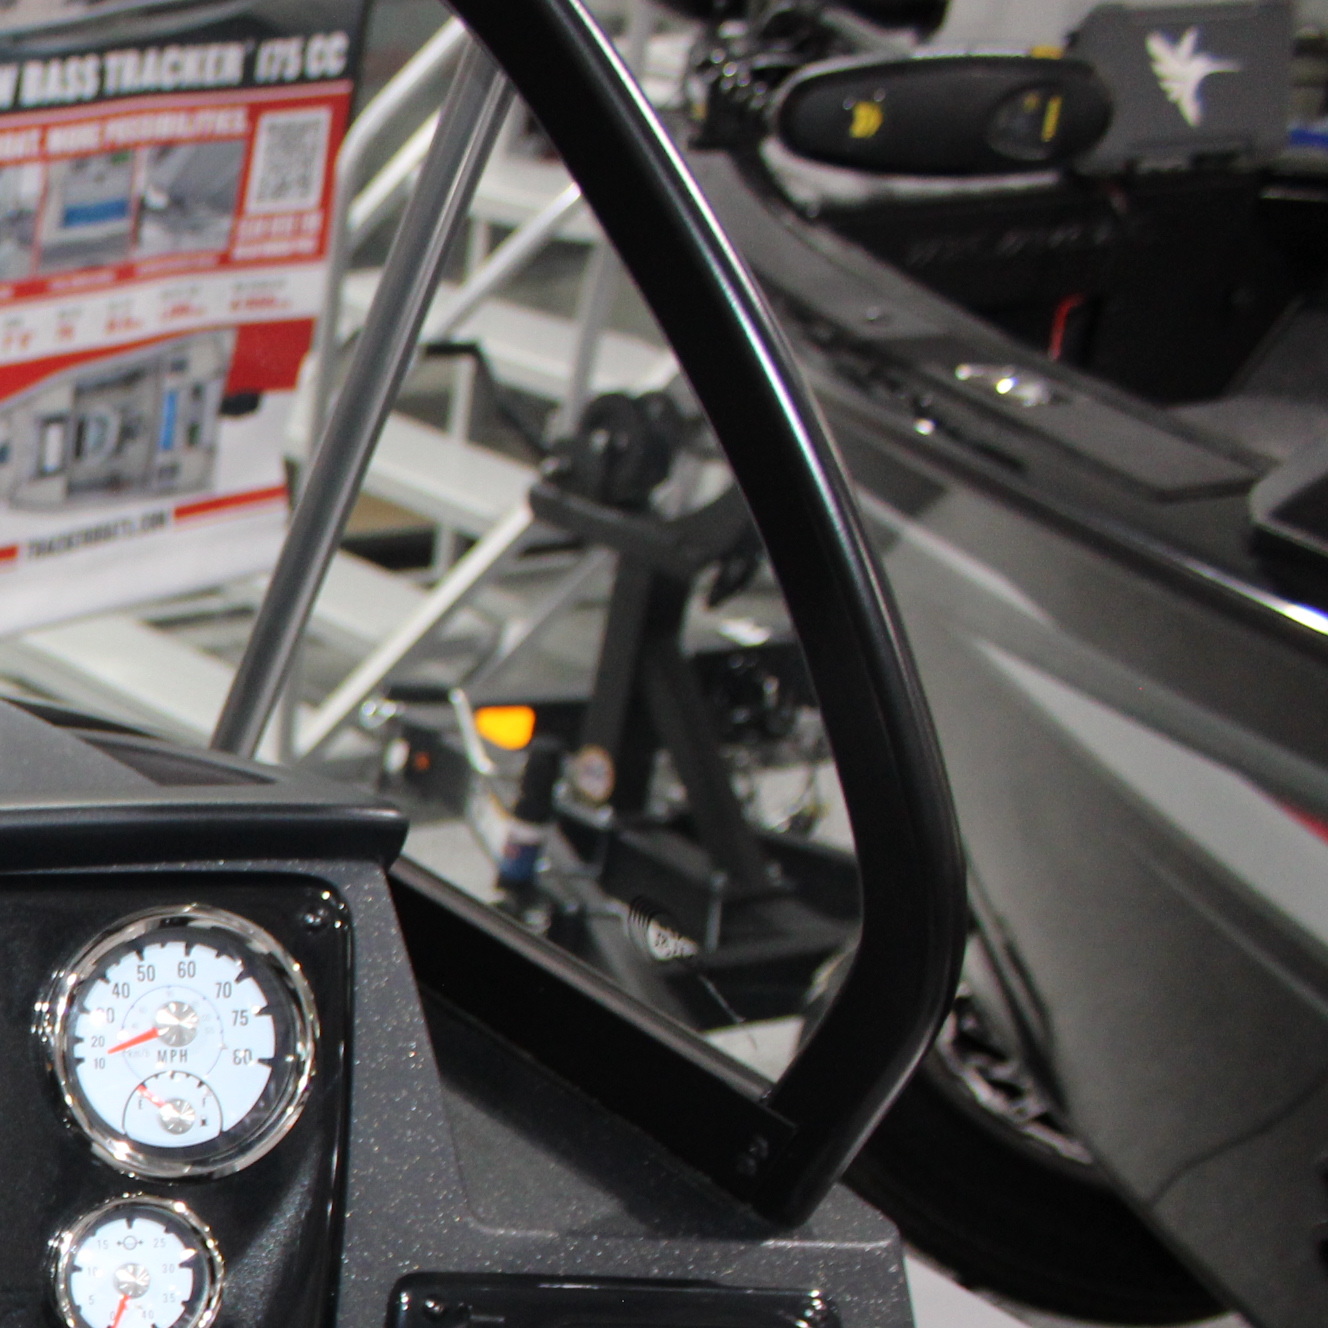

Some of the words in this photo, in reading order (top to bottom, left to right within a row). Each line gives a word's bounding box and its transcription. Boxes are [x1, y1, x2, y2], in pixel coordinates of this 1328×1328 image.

[20, 54, 102, 106] BASS
[305, 30, 350, 79] CC
[137, 964, 156, 983] 50
[177, 961, 196, 979] 60
[111, 982, 131, 1000] 40
[215, 981, 233, 999] 70
[231, 1009, 249, 1027] 75
[91, 1035, 106, 1048] 20
[93, 1057, 106, 1070] 10
[157, 1049, 188, 1064] MPH
